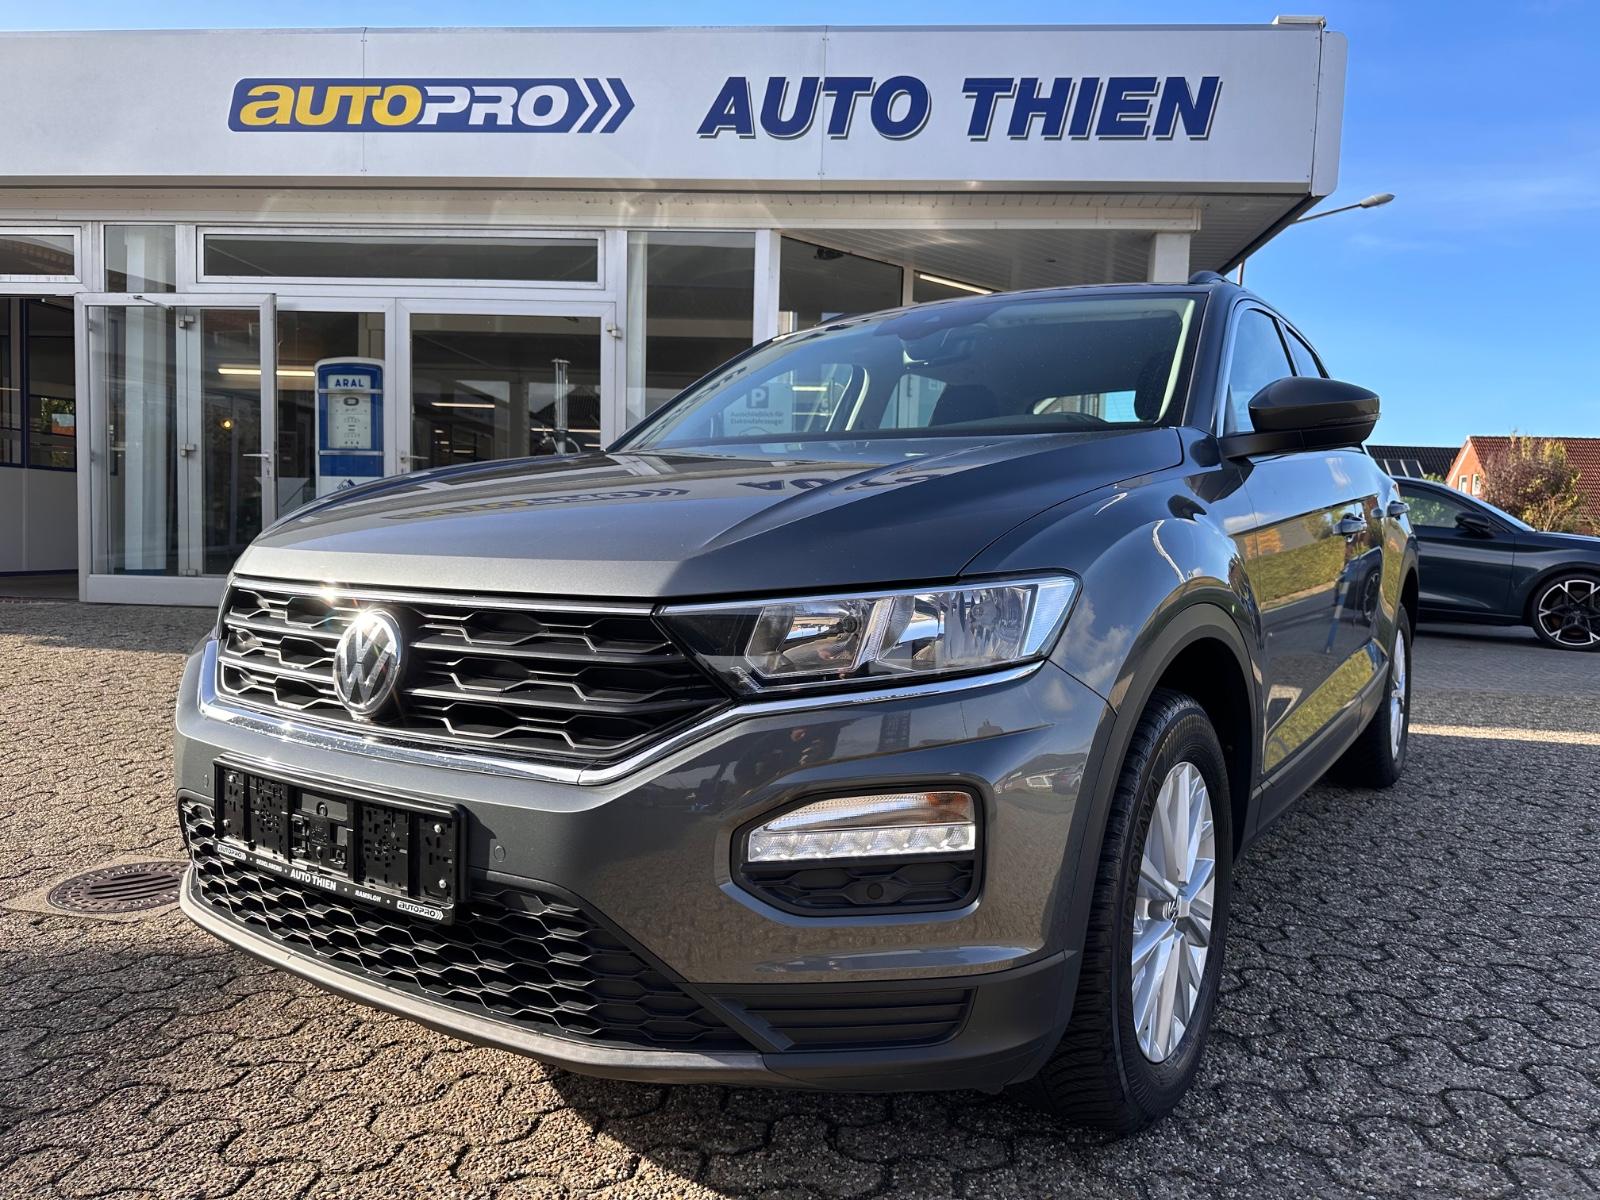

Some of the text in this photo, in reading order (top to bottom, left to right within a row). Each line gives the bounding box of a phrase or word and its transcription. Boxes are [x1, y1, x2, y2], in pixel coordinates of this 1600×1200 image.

[697, 76, 1222, 141] AUTO THIEN
[335, 379, 364, 388] ARAL
[290, 868, 311, 883] AUTO
[312, 875, 337, 891] THIEN
